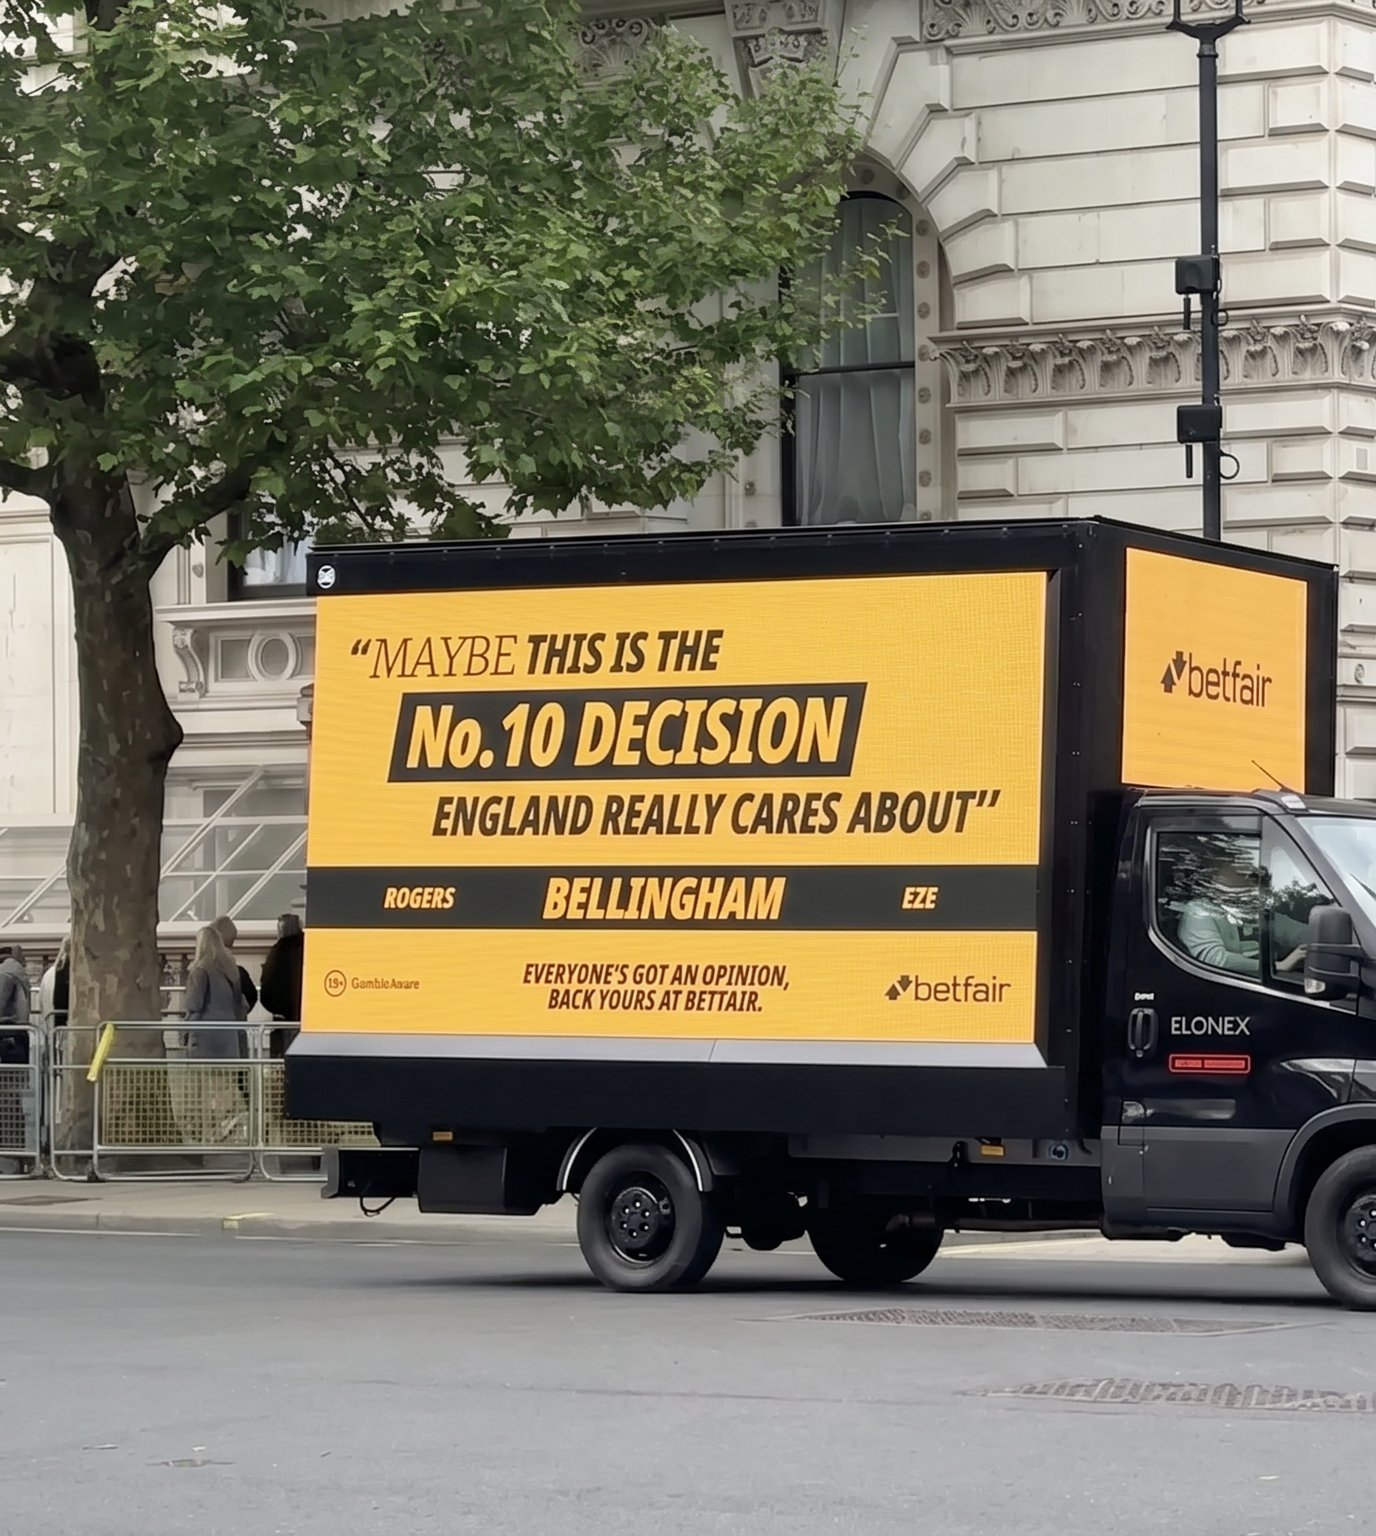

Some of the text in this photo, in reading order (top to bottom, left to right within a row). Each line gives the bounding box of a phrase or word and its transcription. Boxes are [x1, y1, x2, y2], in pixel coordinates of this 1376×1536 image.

[350, 629, 725, 679] “MAYBE THIS IS THE
[1188, 652, 1273, 708] betfair
[573, 696, 848, 766] DECISION
[431, 789, 1001, 837] ENGLAND REALLY CARES ABOUT”
[383, 887, 456, 909] ROGERS
[542, 876, 787, 920] BELLINGHAM
[901, 886, 939, 909] EZE
[522, 963, 790, 991] EVERYONE'S GOT AN OPINION,
[914, 974, 1012, 1003] betfair
[547, 988, 596, 1010] BACK
[599, 989, 657, 1011] YOURS
[657, 989, 683, 1011] AT
[1171, 1016, 1251, 1036] ELONEX
